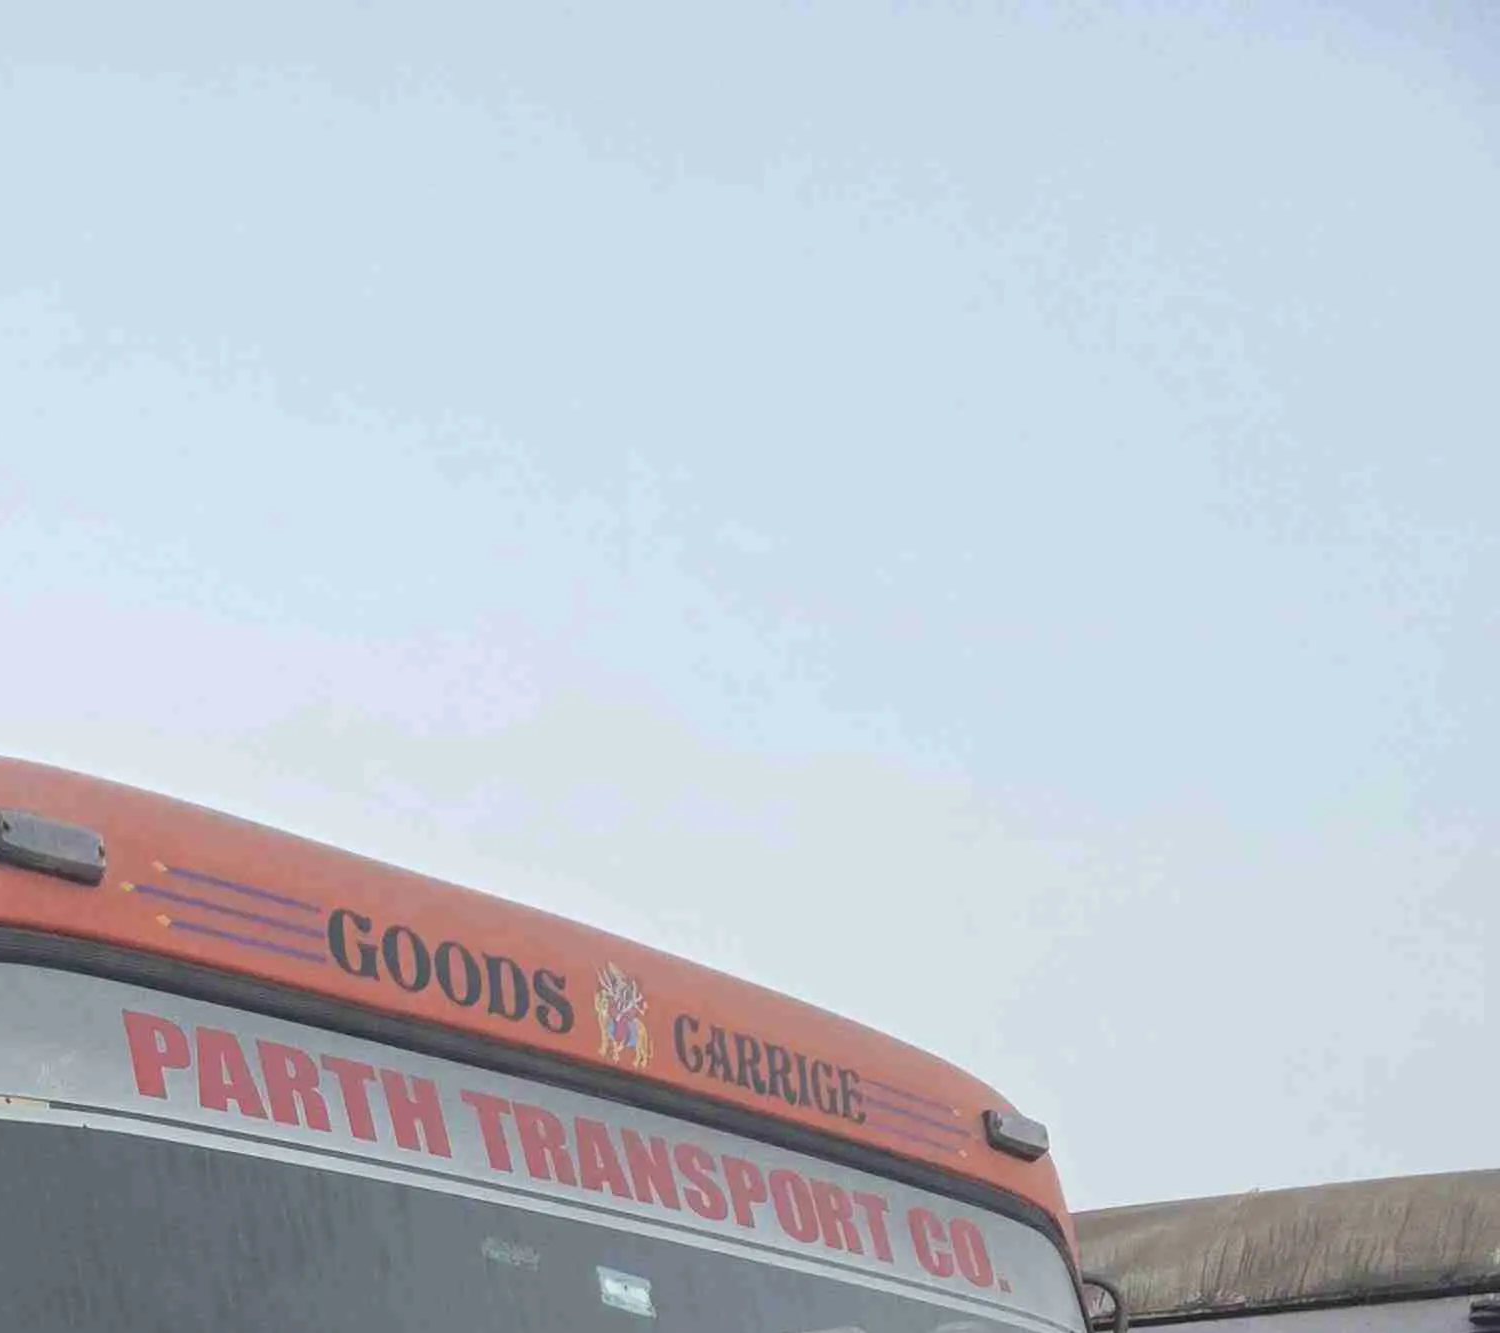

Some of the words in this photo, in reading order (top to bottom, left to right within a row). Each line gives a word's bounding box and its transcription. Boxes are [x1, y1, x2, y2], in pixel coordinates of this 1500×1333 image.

[326, 907, 575, 1035] GOODS
[122, 1008, 453, 1159] PARTH
[461, 1088, 895, 1265] TRANSPORT
[906, 1205, 1012, 1294] CO.
